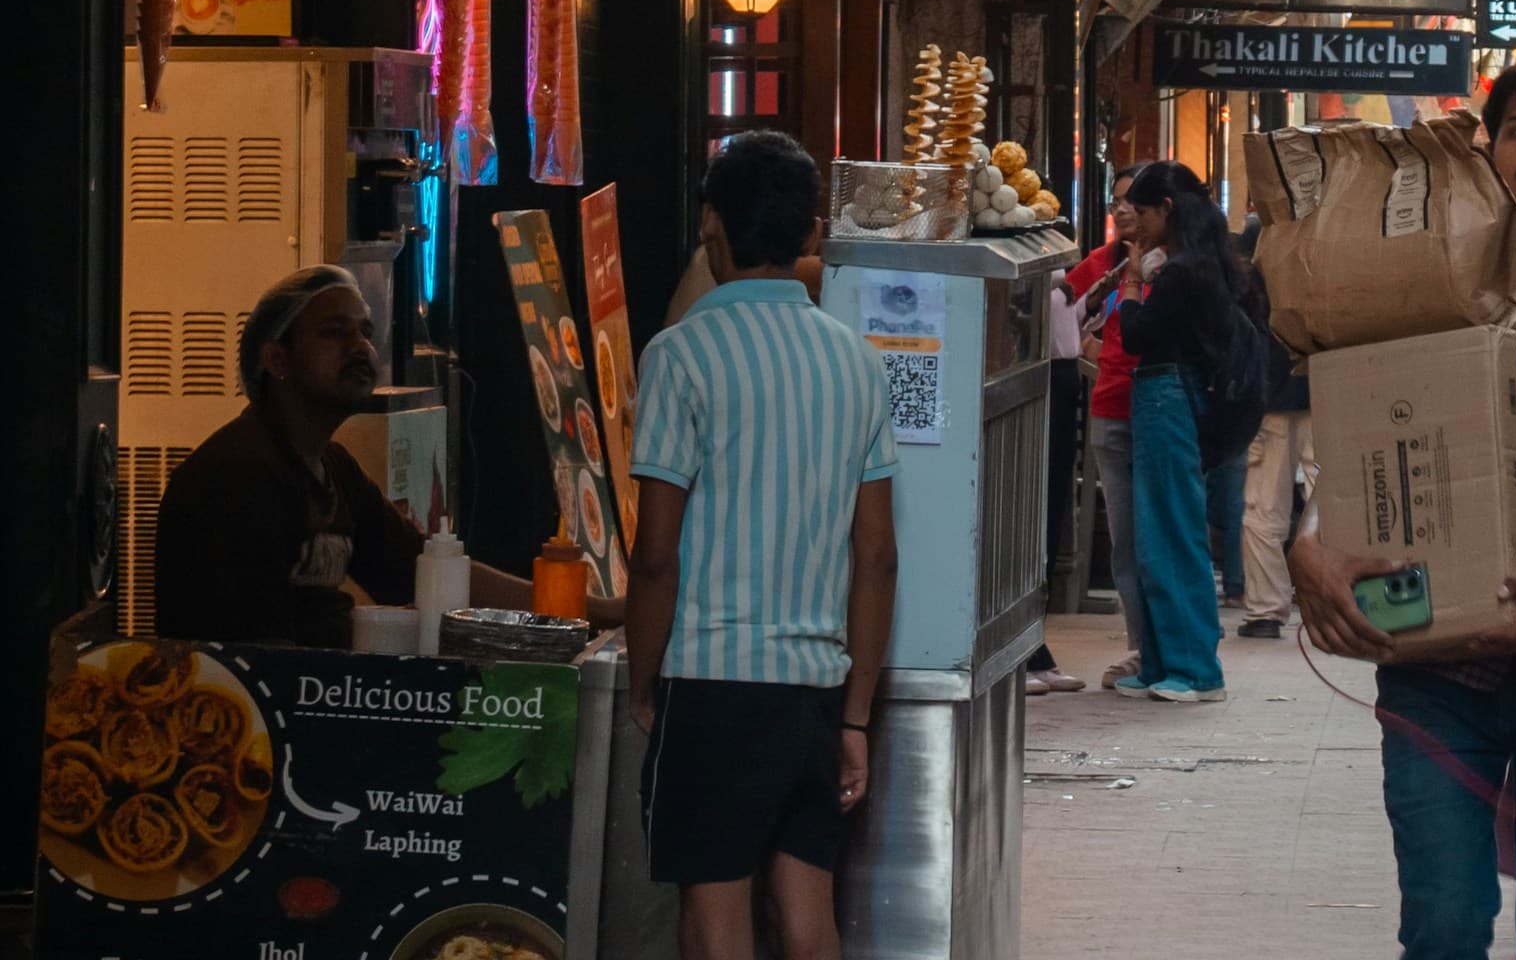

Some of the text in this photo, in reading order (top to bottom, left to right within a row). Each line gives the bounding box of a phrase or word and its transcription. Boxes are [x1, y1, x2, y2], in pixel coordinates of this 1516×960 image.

[1164, 28, 1300, 63] Thakali
[1312, 33, 1449, 66] Kitchen
[1370, 449, 1391, 544] amazon.in
[297, 676, 544, 720] Delicious Food
[366, 789, 464, 817] WaiWai
[364, 829, 462, 861] Laphing
